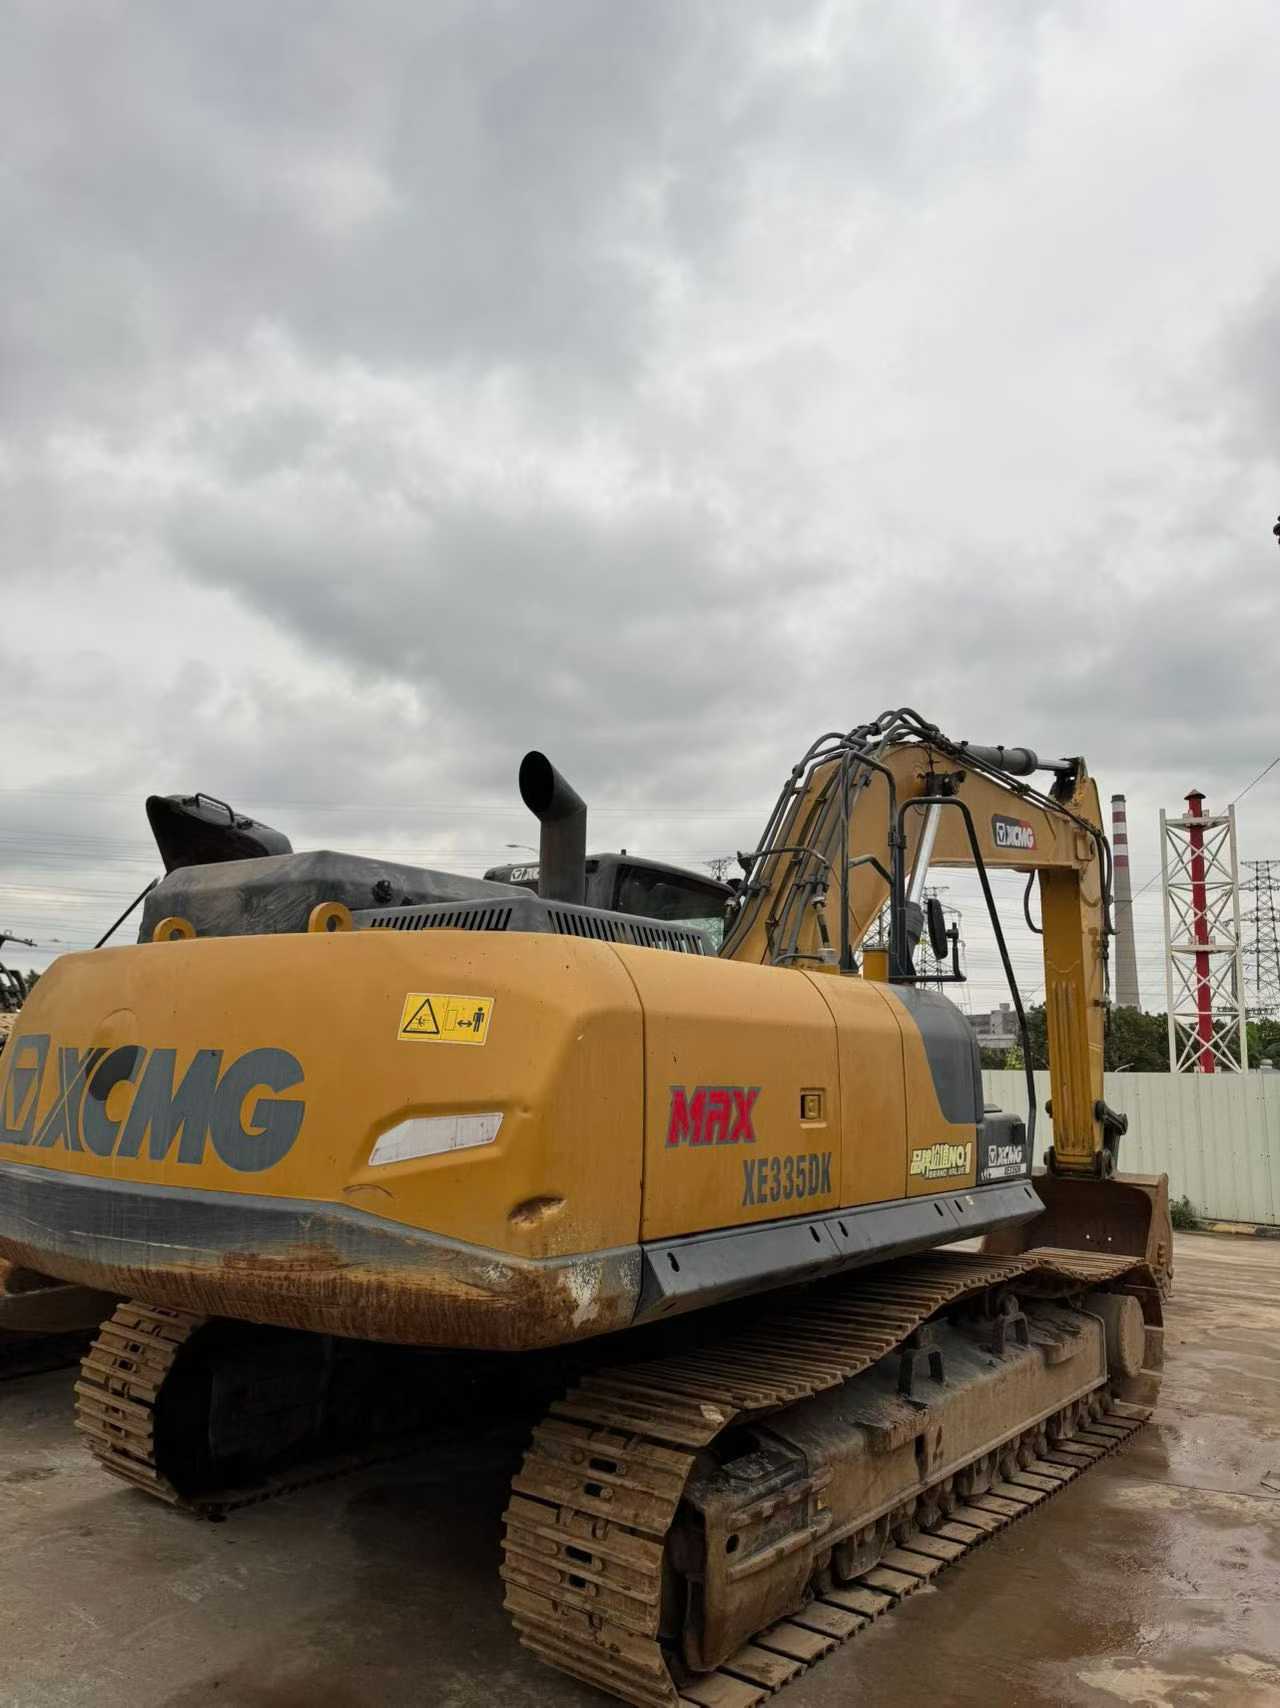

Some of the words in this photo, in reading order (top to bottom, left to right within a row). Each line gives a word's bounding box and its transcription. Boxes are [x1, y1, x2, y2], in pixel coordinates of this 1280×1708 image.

[1005, 825, 1035, 849] XCMG
[31, 1045, 305, 1173] XCMG
[665, 1085, 762, 1149] MAX
[742, 1151, 832, 1206] XE335DK
[997, 1145, 1023, 1167] XCMG
